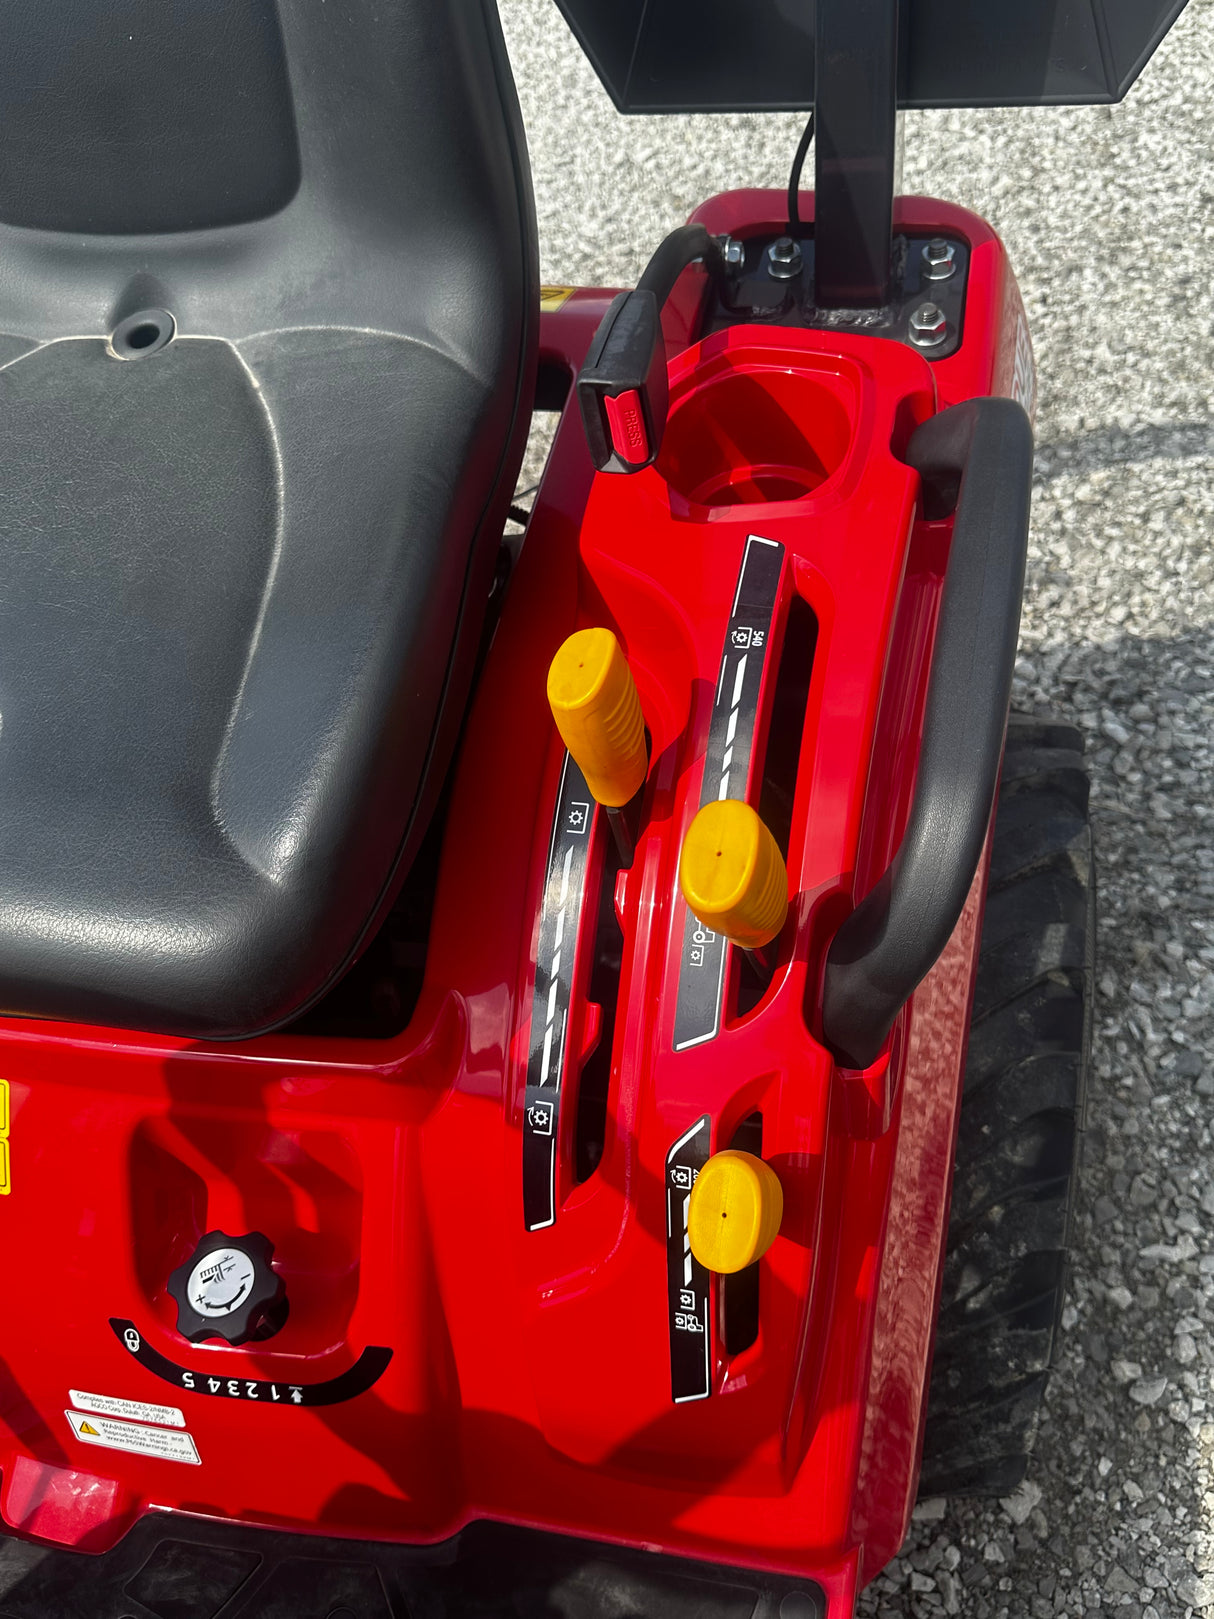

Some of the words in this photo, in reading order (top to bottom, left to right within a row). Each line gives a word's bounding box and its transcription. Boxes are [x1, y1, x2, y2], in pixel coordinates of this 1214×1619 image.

[624, 408, 643, 448] PRESS
[751, 630, 765, 647] 540
[182, 1372, 195, 1388] 5
[207, 1377, 221, 1393] 4
[227, 1380, 240, 1397] 3
[245, 1382, 259, 1397] 2
[270, 1385, 281, 1401] 1
